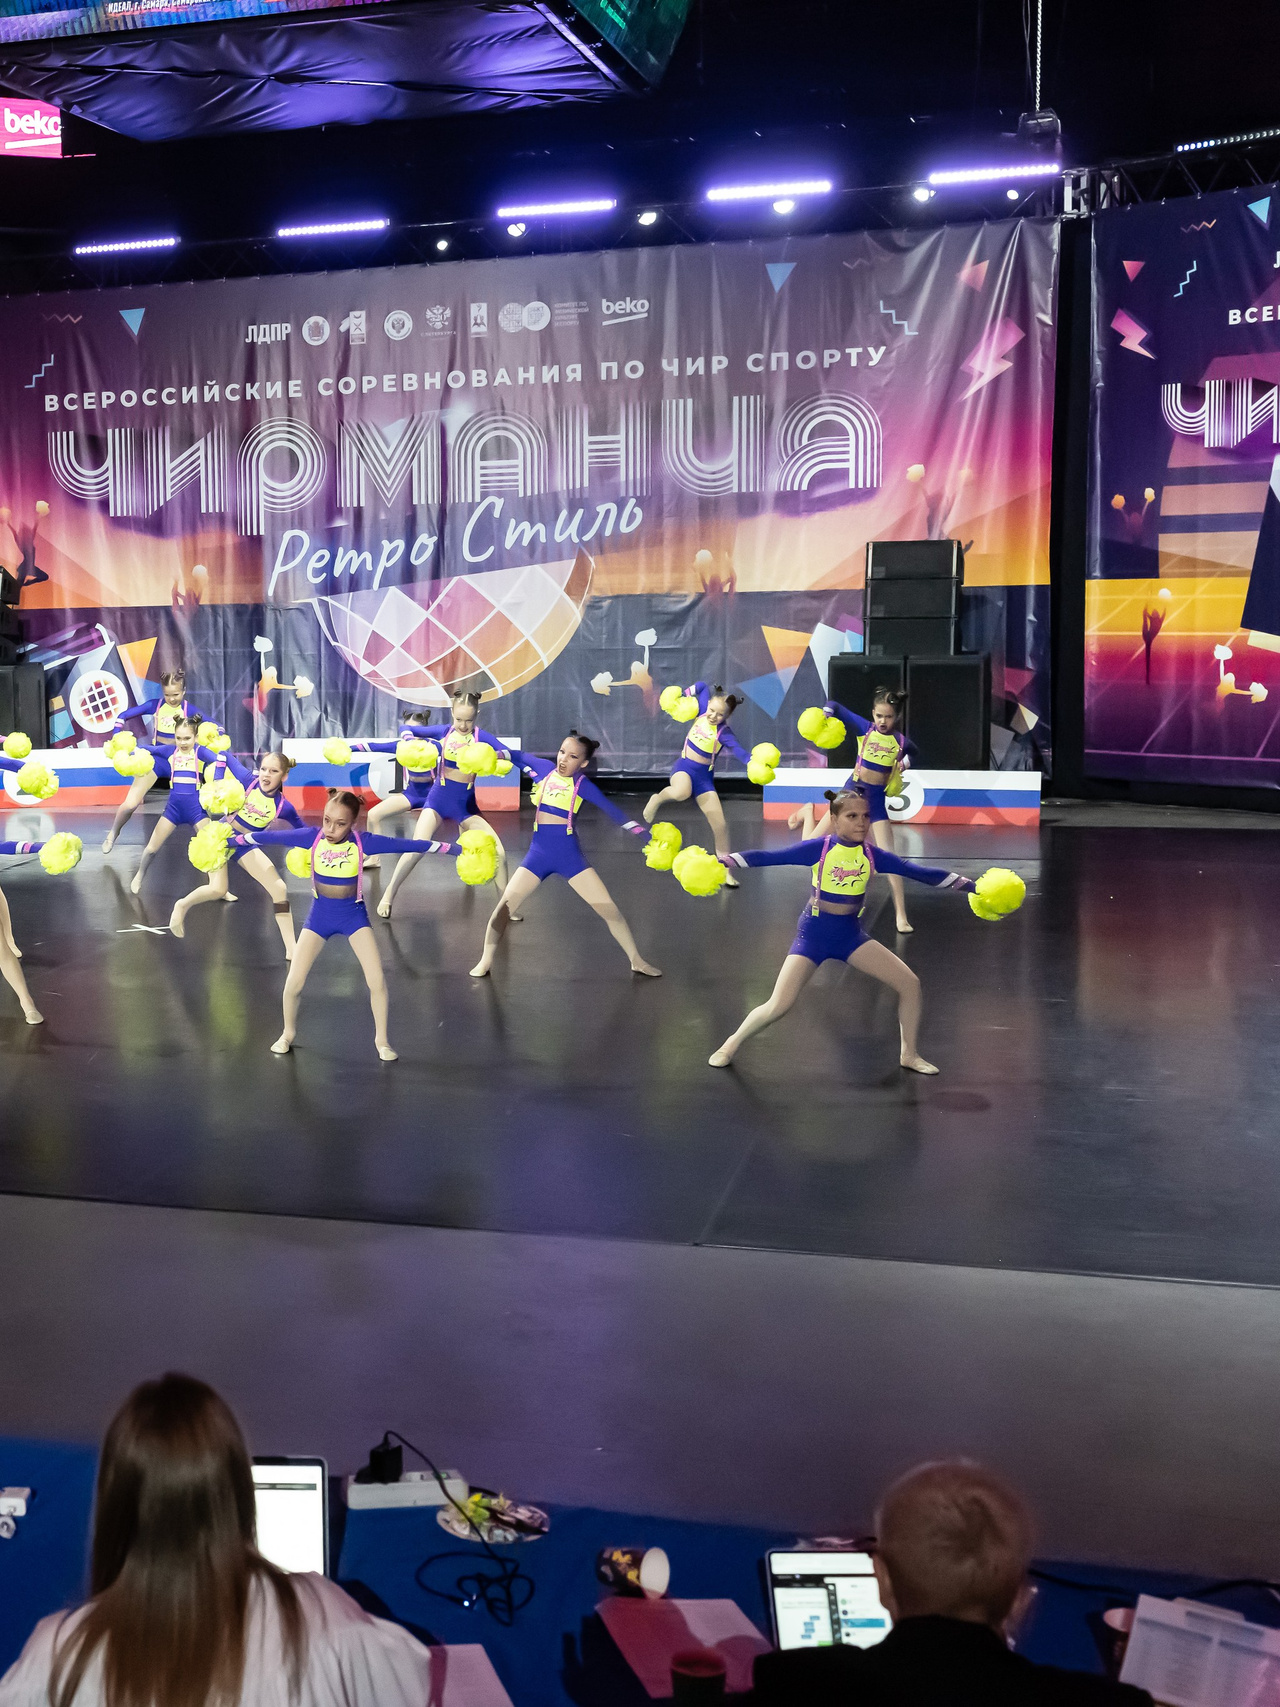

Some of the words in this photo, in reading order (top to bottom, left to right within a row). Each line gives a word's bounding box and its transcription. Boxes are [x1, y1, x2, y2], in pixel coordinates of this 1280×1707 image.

[4, 107, 62, 135] beko
[601, 297, 650, 315] beko
[1228, 304, 1280, 326] ВСЕ
[245, 323, 291, 345] ЛДПР
[44, 380, 303, 412] ВСЕРОССИЙСКИЕ
[317, 363, 582, 396] СОРЕВНОВАНИЯ
[600, 360, 645, 381] ПО
[662, 355, 729, 377] ЧИР
[746, 346, 887, 373] СПОРТУ
[267, 529, 439, 597] Ретро
[462, 495, 643, 563] Стиль
[888, 781, 911, 812] 3
